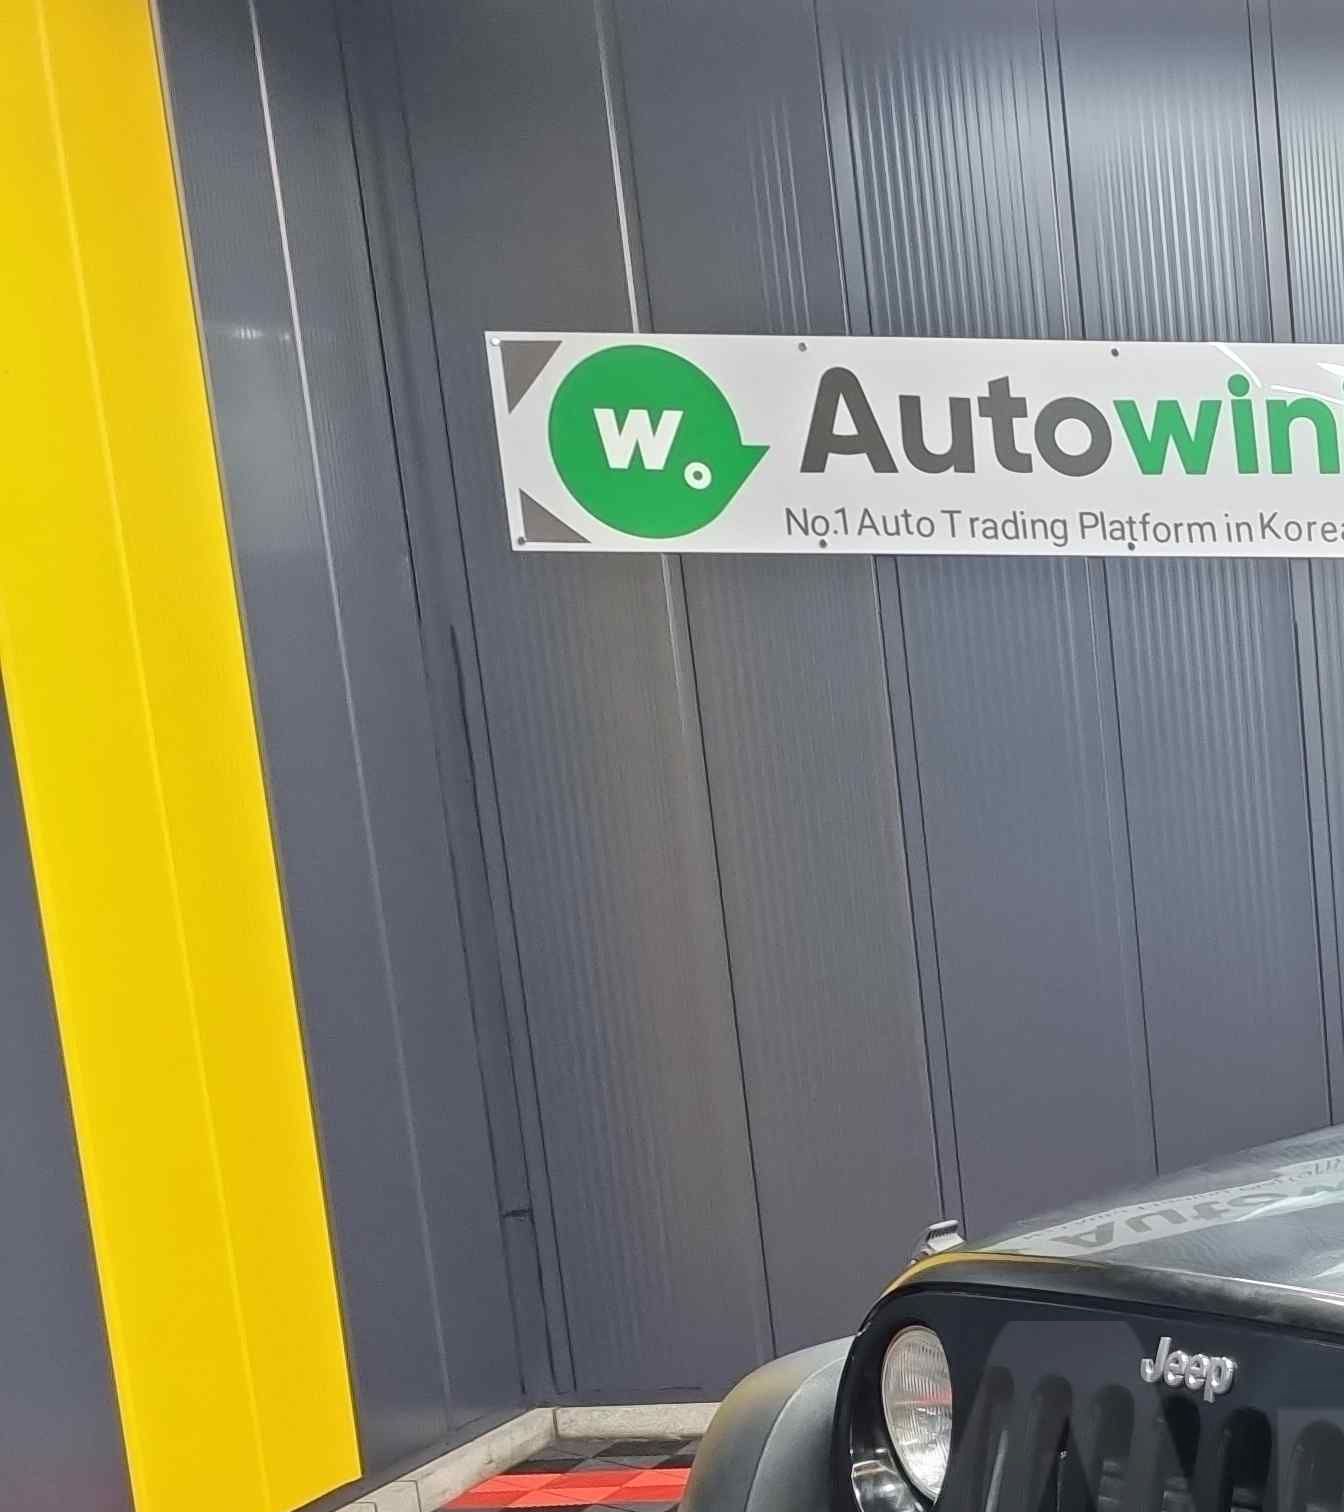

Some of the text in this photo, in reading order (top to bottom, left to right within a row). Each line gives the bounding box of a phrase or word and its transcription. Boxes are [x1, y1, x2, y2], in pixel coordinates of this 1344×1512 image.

[785, 507, 849, 538] No.1
[857, 507, 935, 538] Auto
[941, 509, 1069, 548] Trading
[1079, 511, 1217, 543] Platform
[1224, 512, 1254, 543] in
[1140, 1336, 1235, 1403] Jeep
